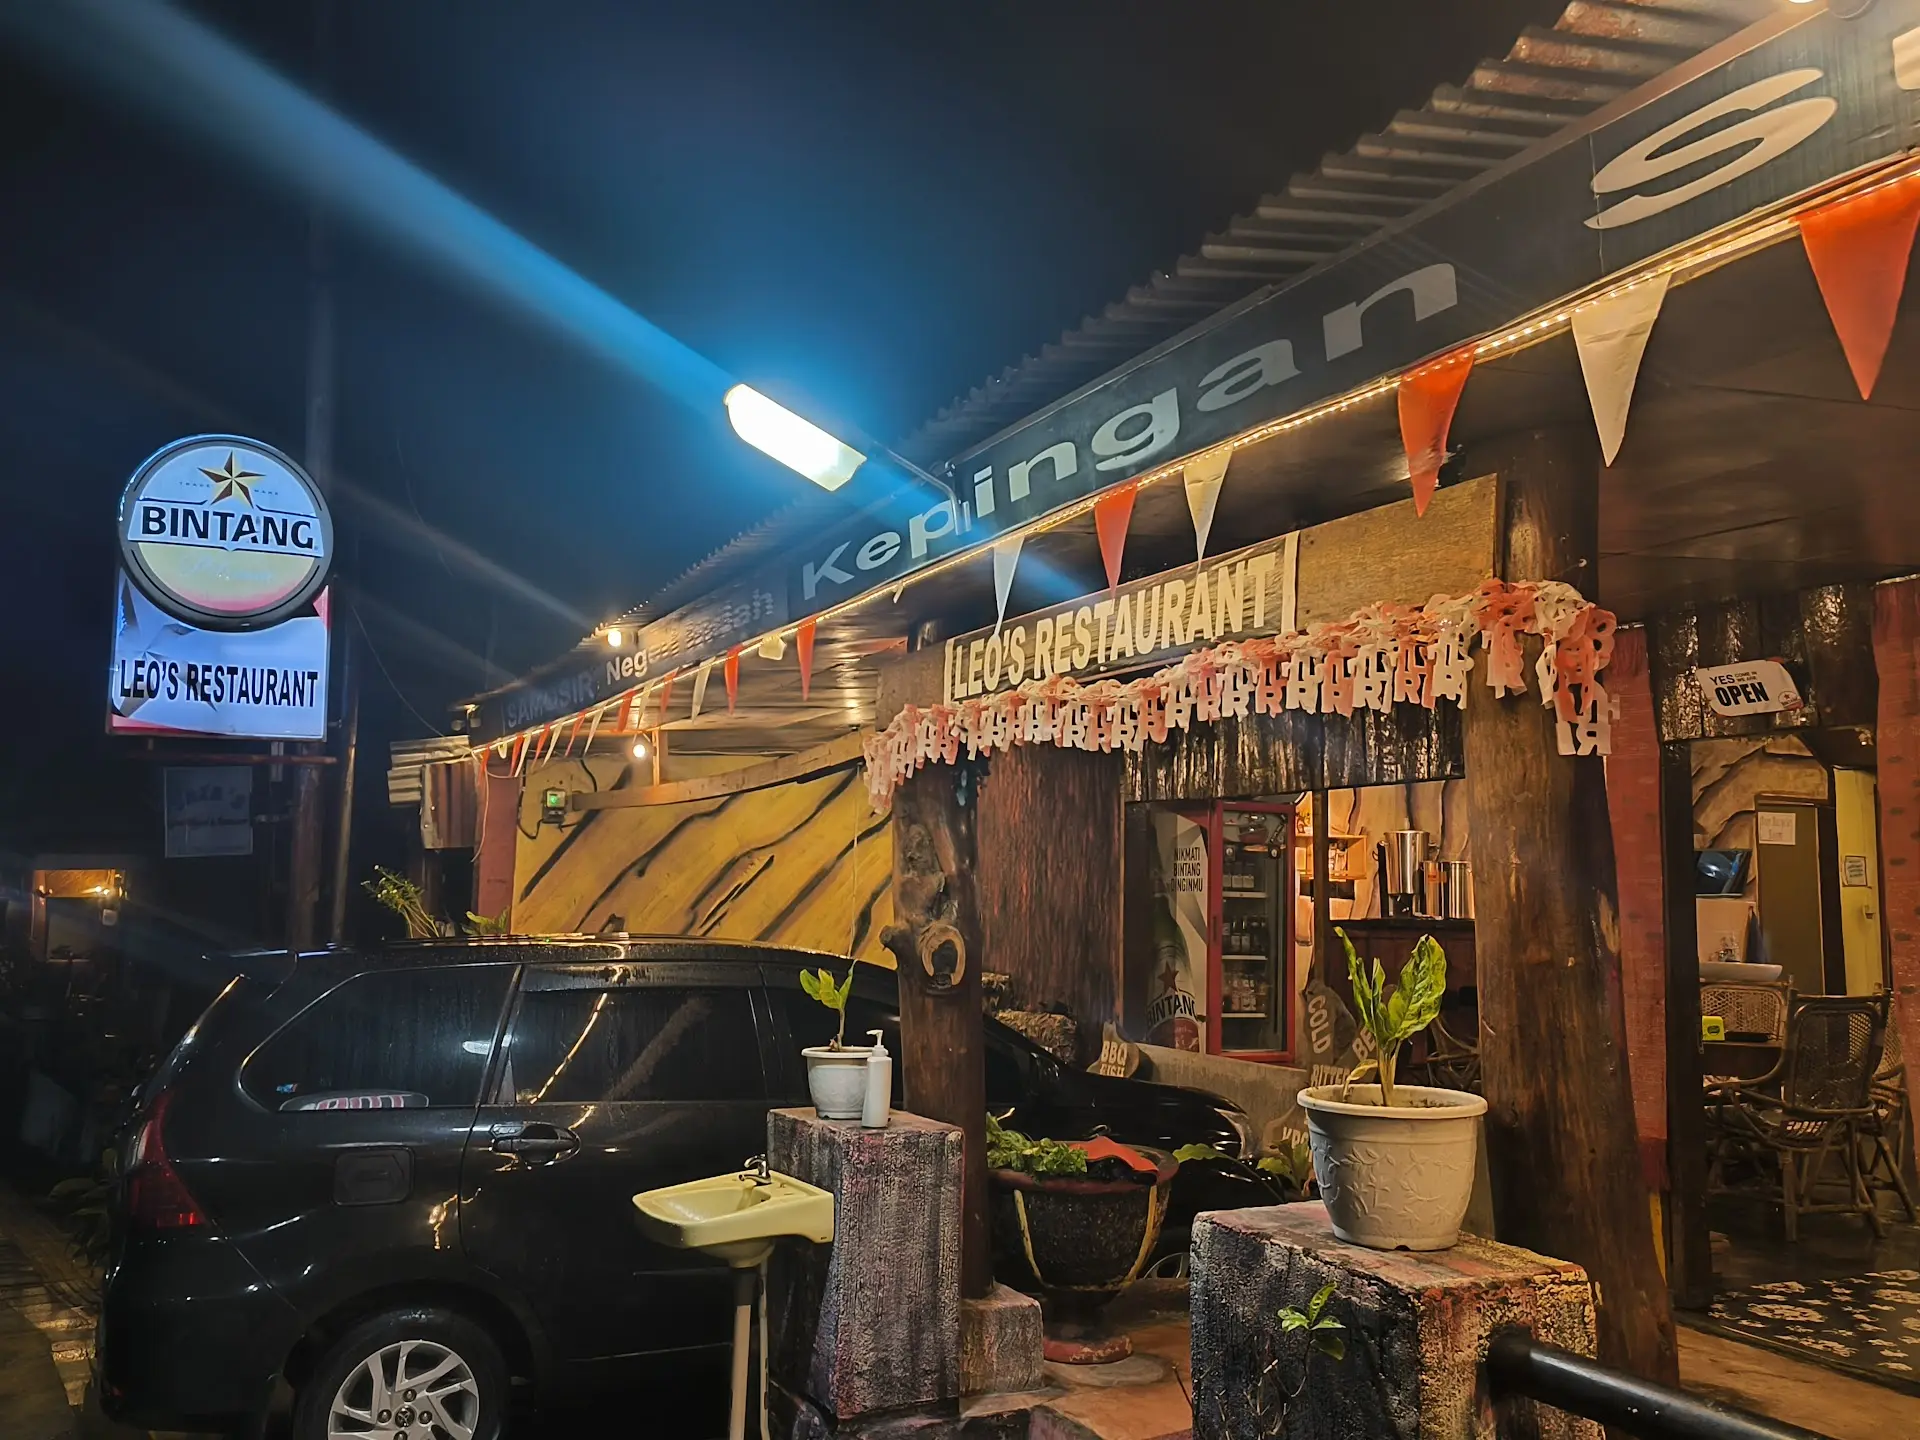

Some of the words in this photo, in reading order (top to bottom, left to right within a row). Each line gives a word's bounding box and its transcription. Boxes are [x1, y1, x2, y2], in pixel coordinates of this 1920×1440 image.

[803, 262, 1459, 601] Kepingan
[1583, 26, 1920, 230] S
[141, 506, 313, 550] BINTANG
[953, 629, 1027, 699] LEO'S
[1033, 552, 1277, 680] RESTAURANT
[120, 659, 179, 701] LEO'S
[186, 663, 318, 707] RESTAURANT
[1709, 674, 1735, 686] YES
[1714, 682, 1769, 707] OPEN
[1174, 847, 1201, 861] NIKMATI
[1173, 863, 1201, 877] BINTANG
[1170, 878, 1203, 892] DINGINMU
[1307, 995, 1332, 1054] COLD
[1100, 1041, 1128, 1066] BBQ
